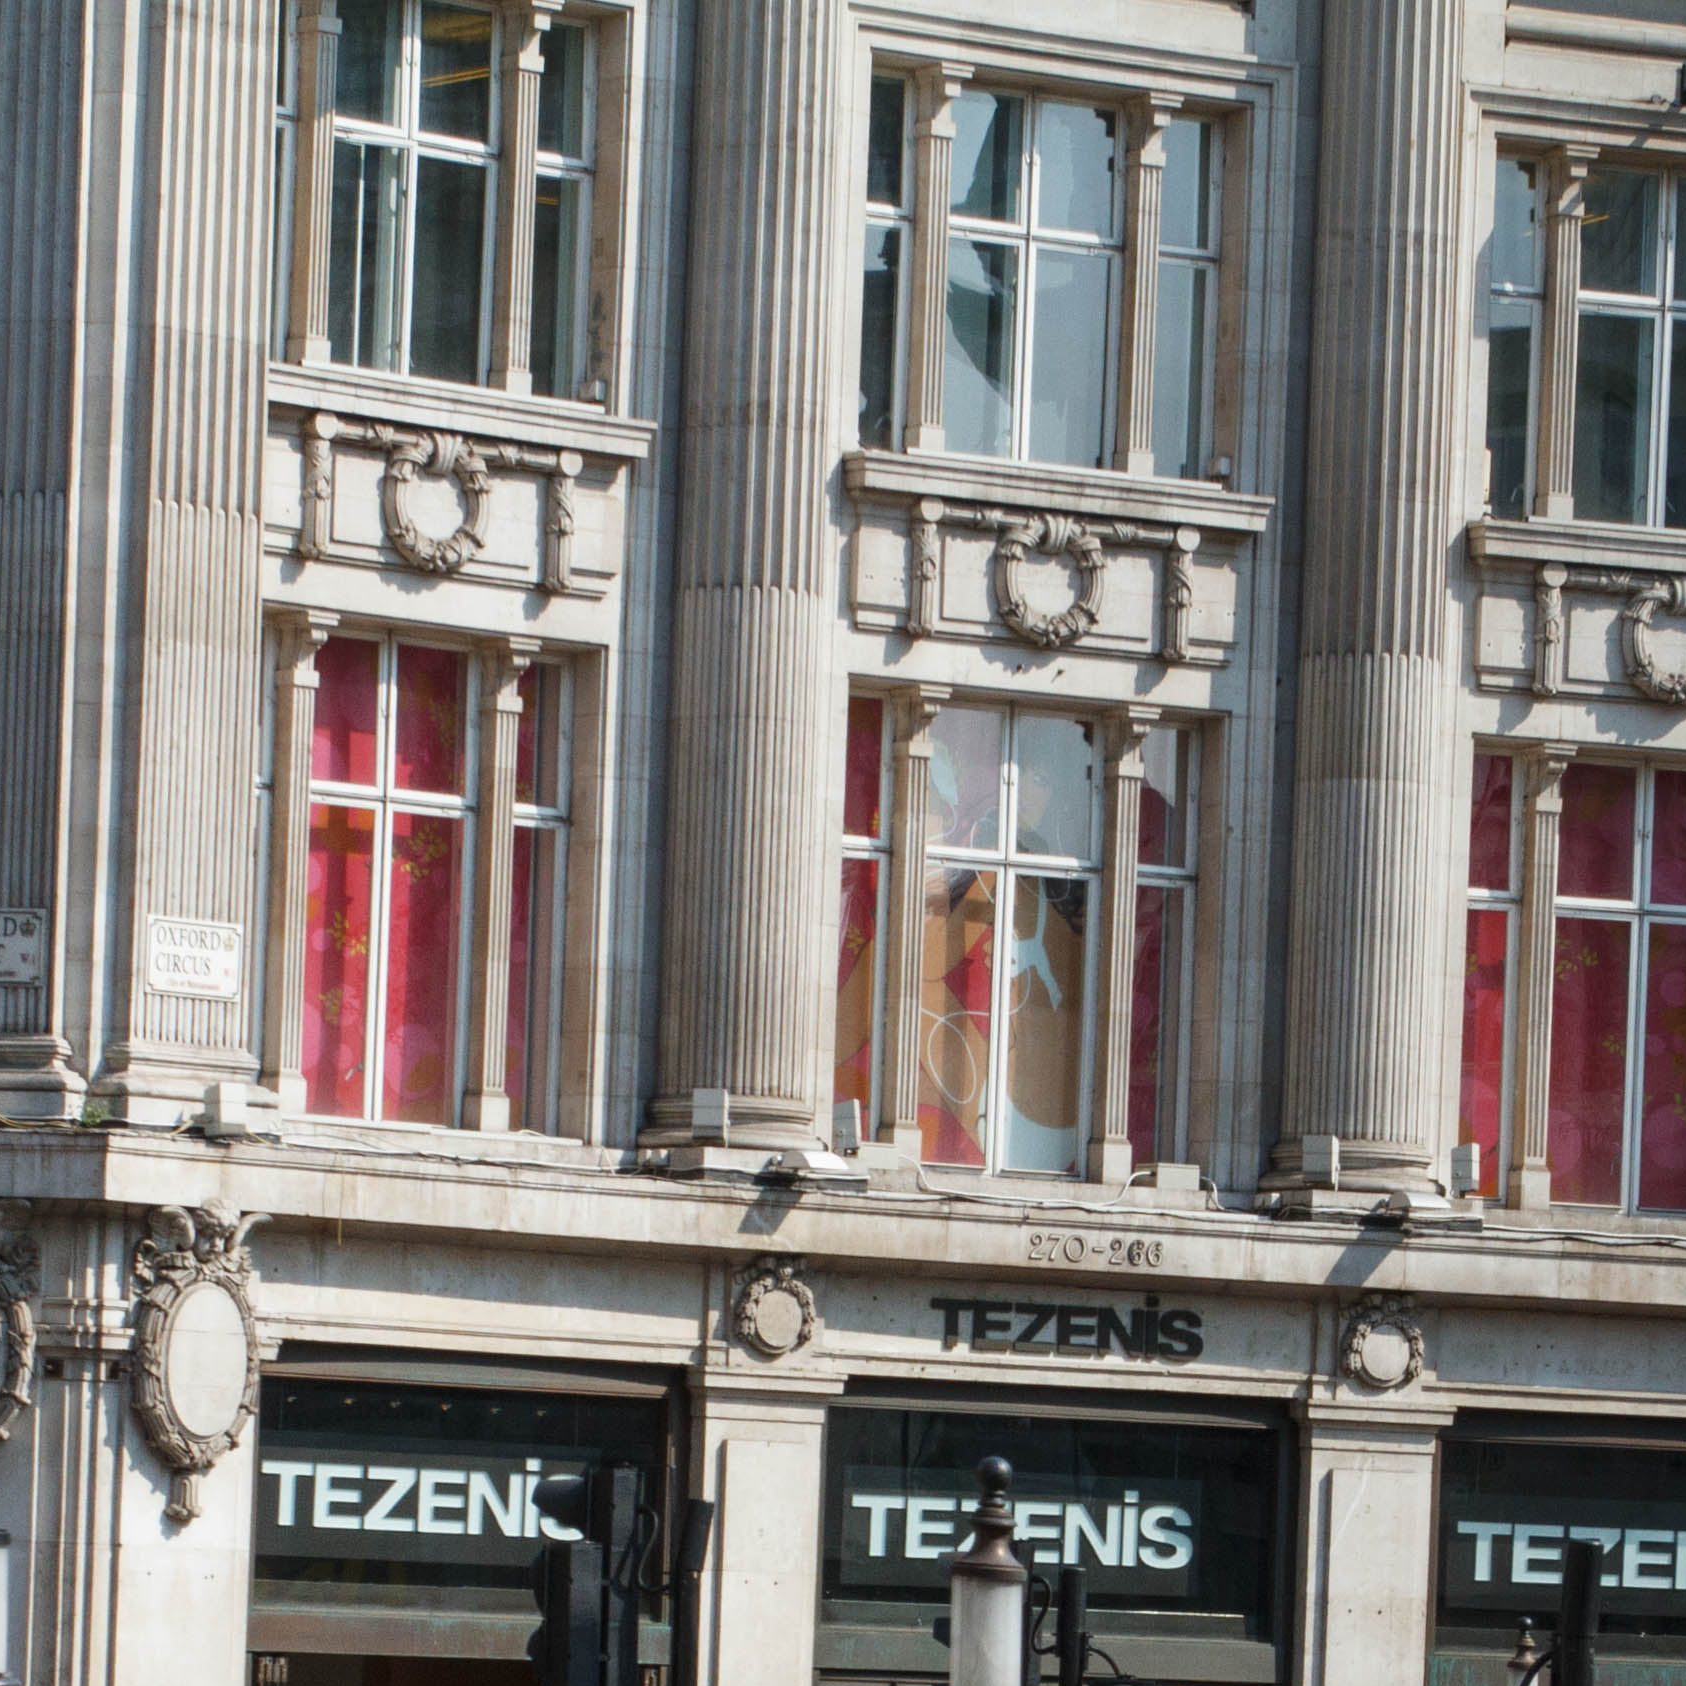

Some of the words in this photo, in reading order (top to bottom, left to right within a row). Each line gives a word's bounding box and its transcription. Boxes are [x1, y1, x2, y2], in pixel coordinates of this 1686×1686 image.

[156, 926, 222, 951] OXFORD
[155, 951, 211, 977] CIRCUS
[1028, 1232, 1164, 1268] 270-266
